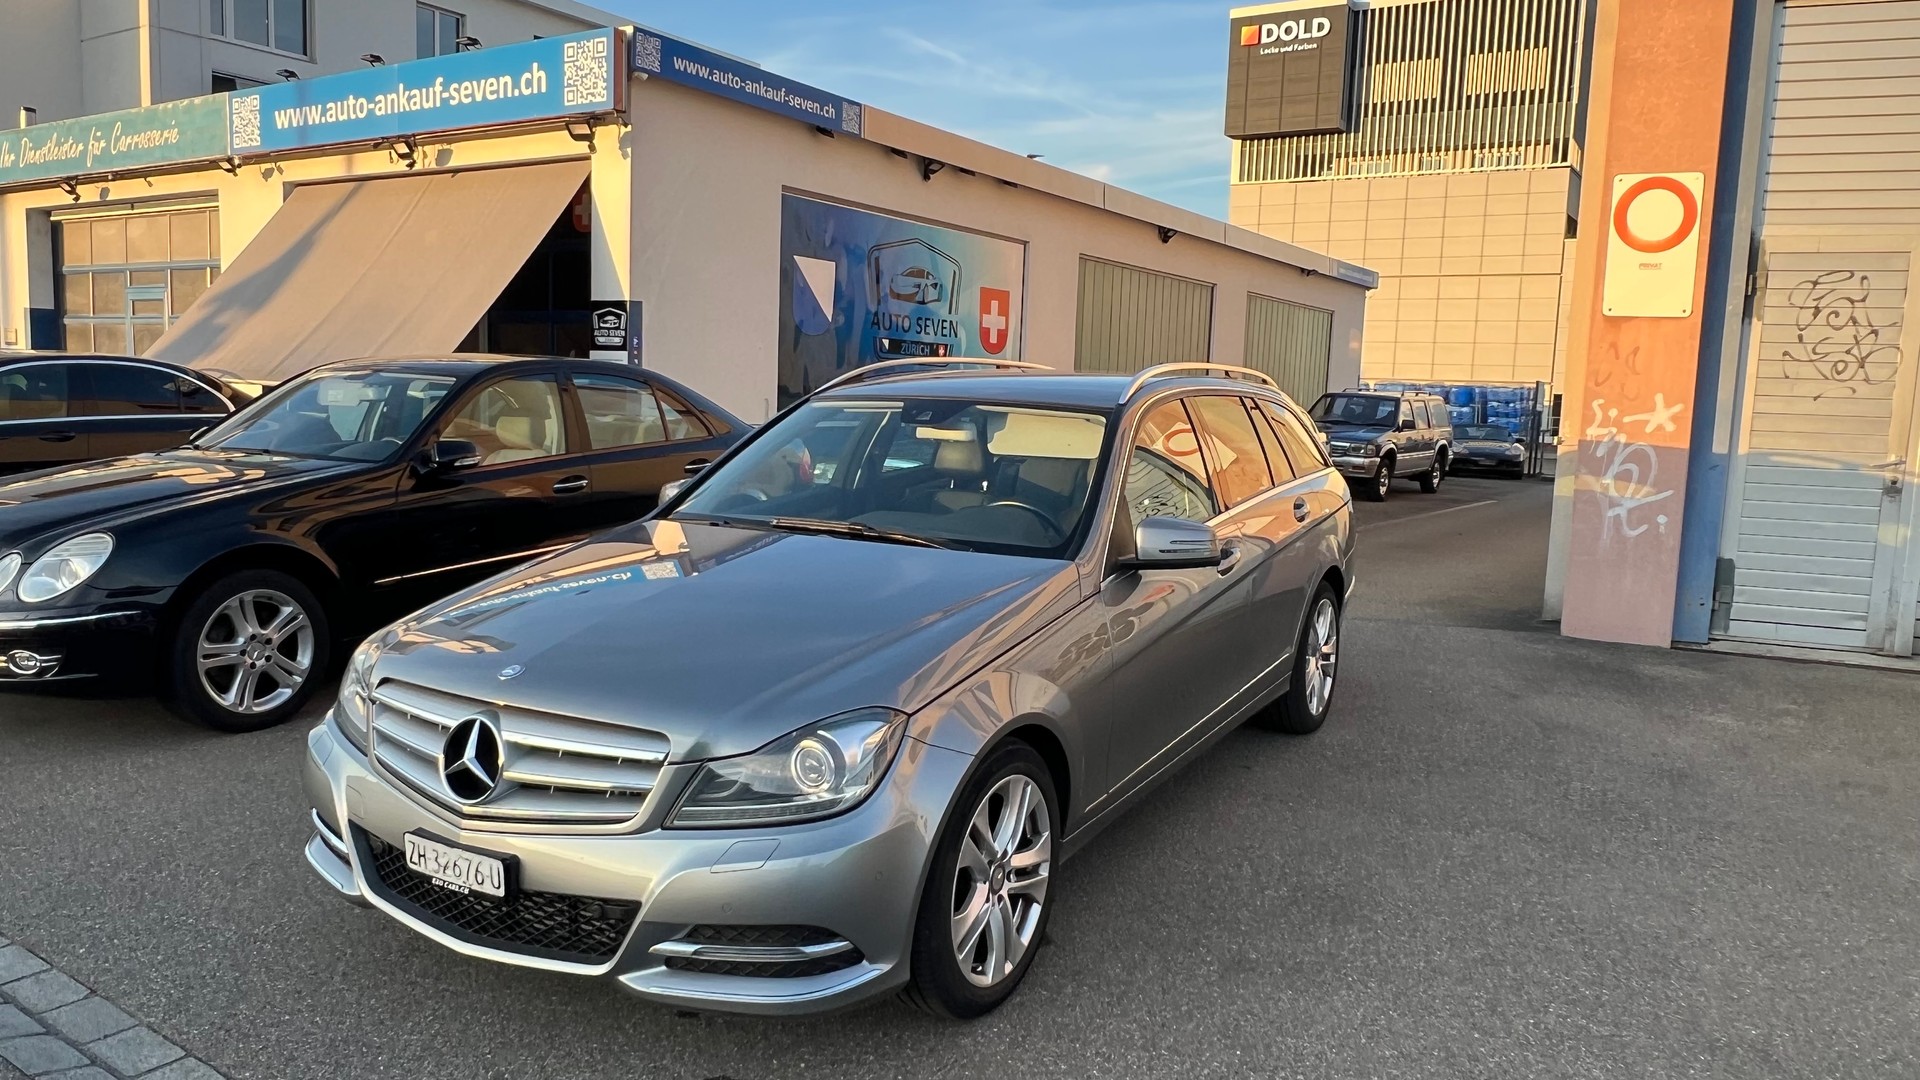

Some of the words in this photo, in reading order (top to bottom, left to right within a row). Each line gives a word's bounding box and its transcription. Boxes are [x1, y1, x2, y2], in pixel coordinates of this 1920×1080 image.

[1260, 17, 1331, 44] DOLD
[1280, 44, 1293, 53] und
[274, 62, 547, 130] www.auto-ankauf-seven.ch
[673, 56, 836, 119] www.auto-ankauf-seven.ch
[0, 140, 16, 168] Ihr
[19, 131, 84, 168] Dienstleister
[86, 126, 107, 168] für
[111, 119, 180, 155] Carrosserie
[609, 329, 626, 337] SEVEN
[871, 310, 912, 334] AUTO
[915, 316, 959, 338] SEVEN
